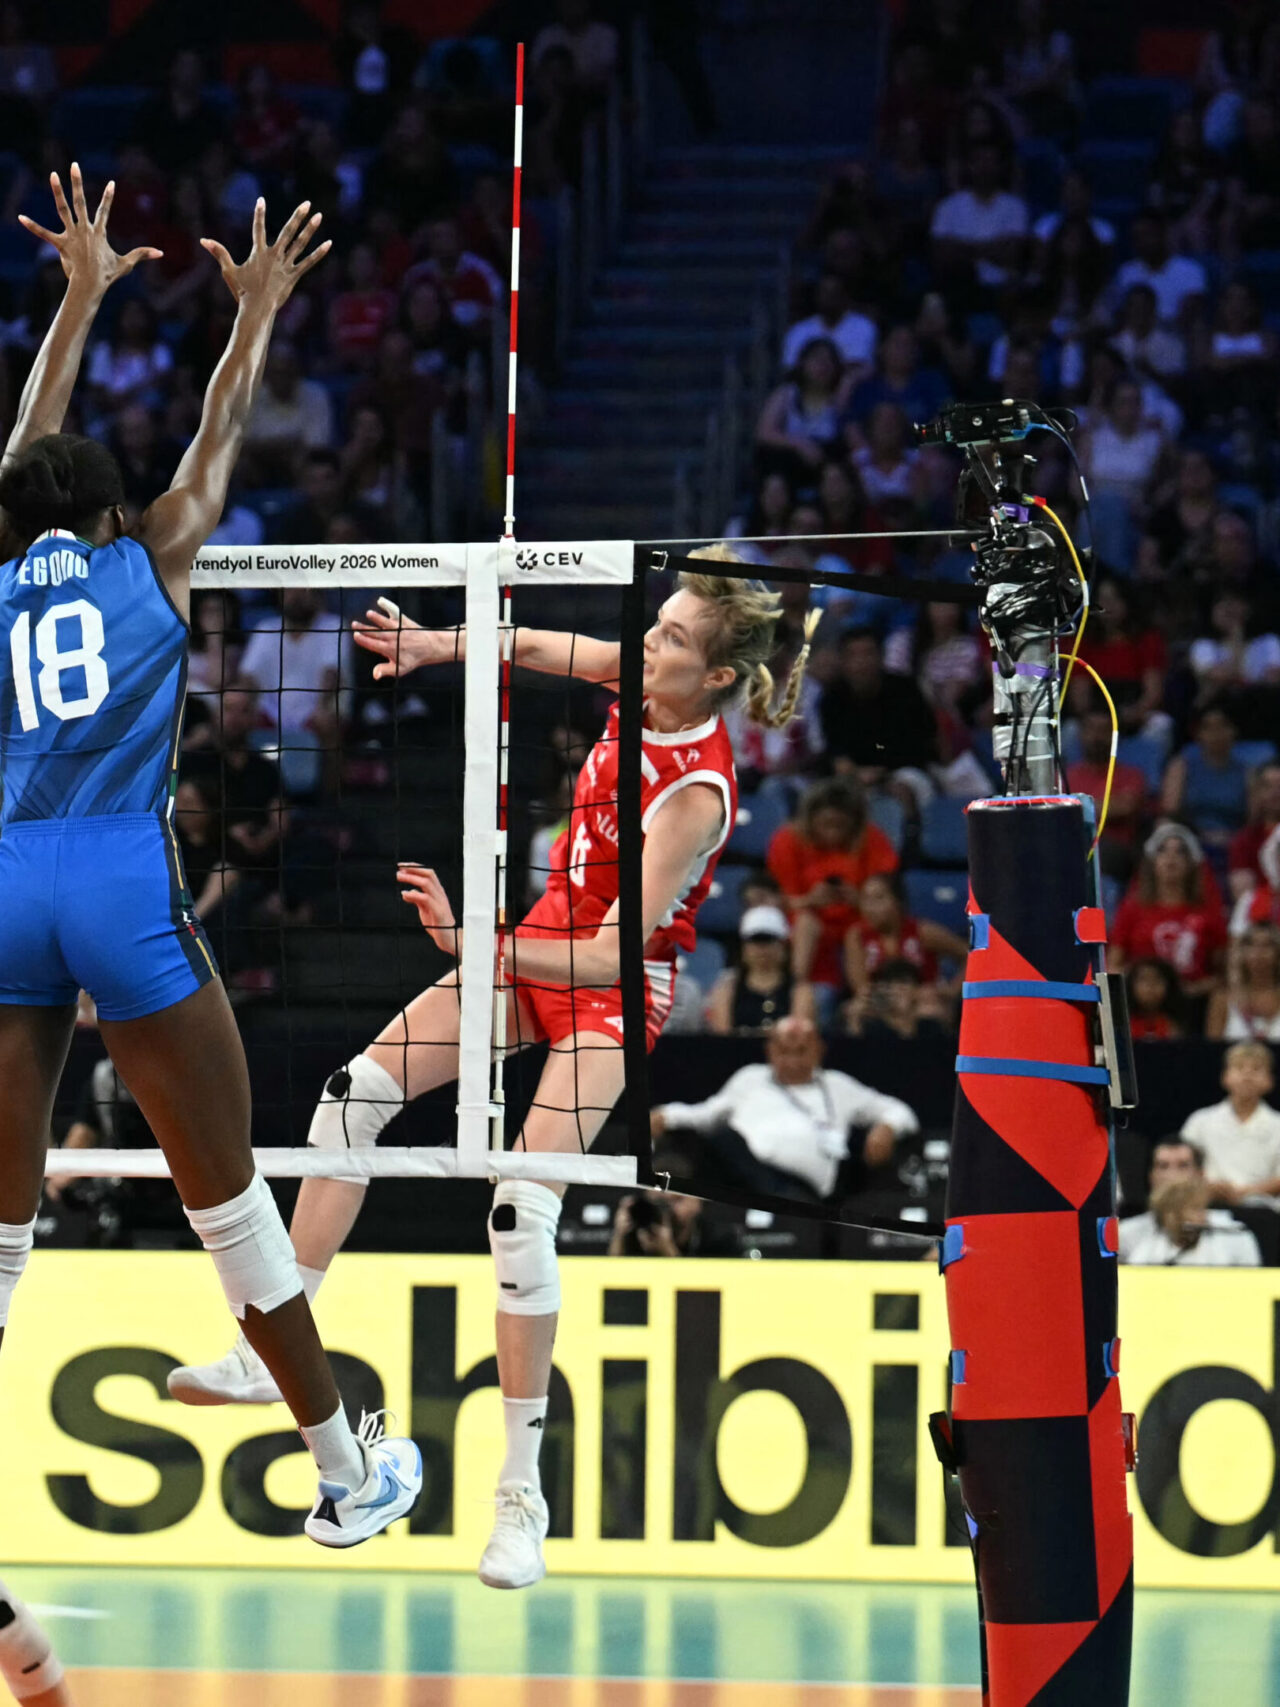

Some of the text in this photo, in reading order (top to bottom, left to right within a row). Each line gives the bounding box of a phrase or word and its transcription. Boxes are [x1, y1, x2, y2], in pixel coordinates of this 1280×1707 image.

[256, 556, 336, 573] EuroVolley
[340, 554, 377, 569] 2026
[381, 554, 439, 569] Women
[543, 552, 583, 566] CEV
[10, 599, 110, 733] 18
